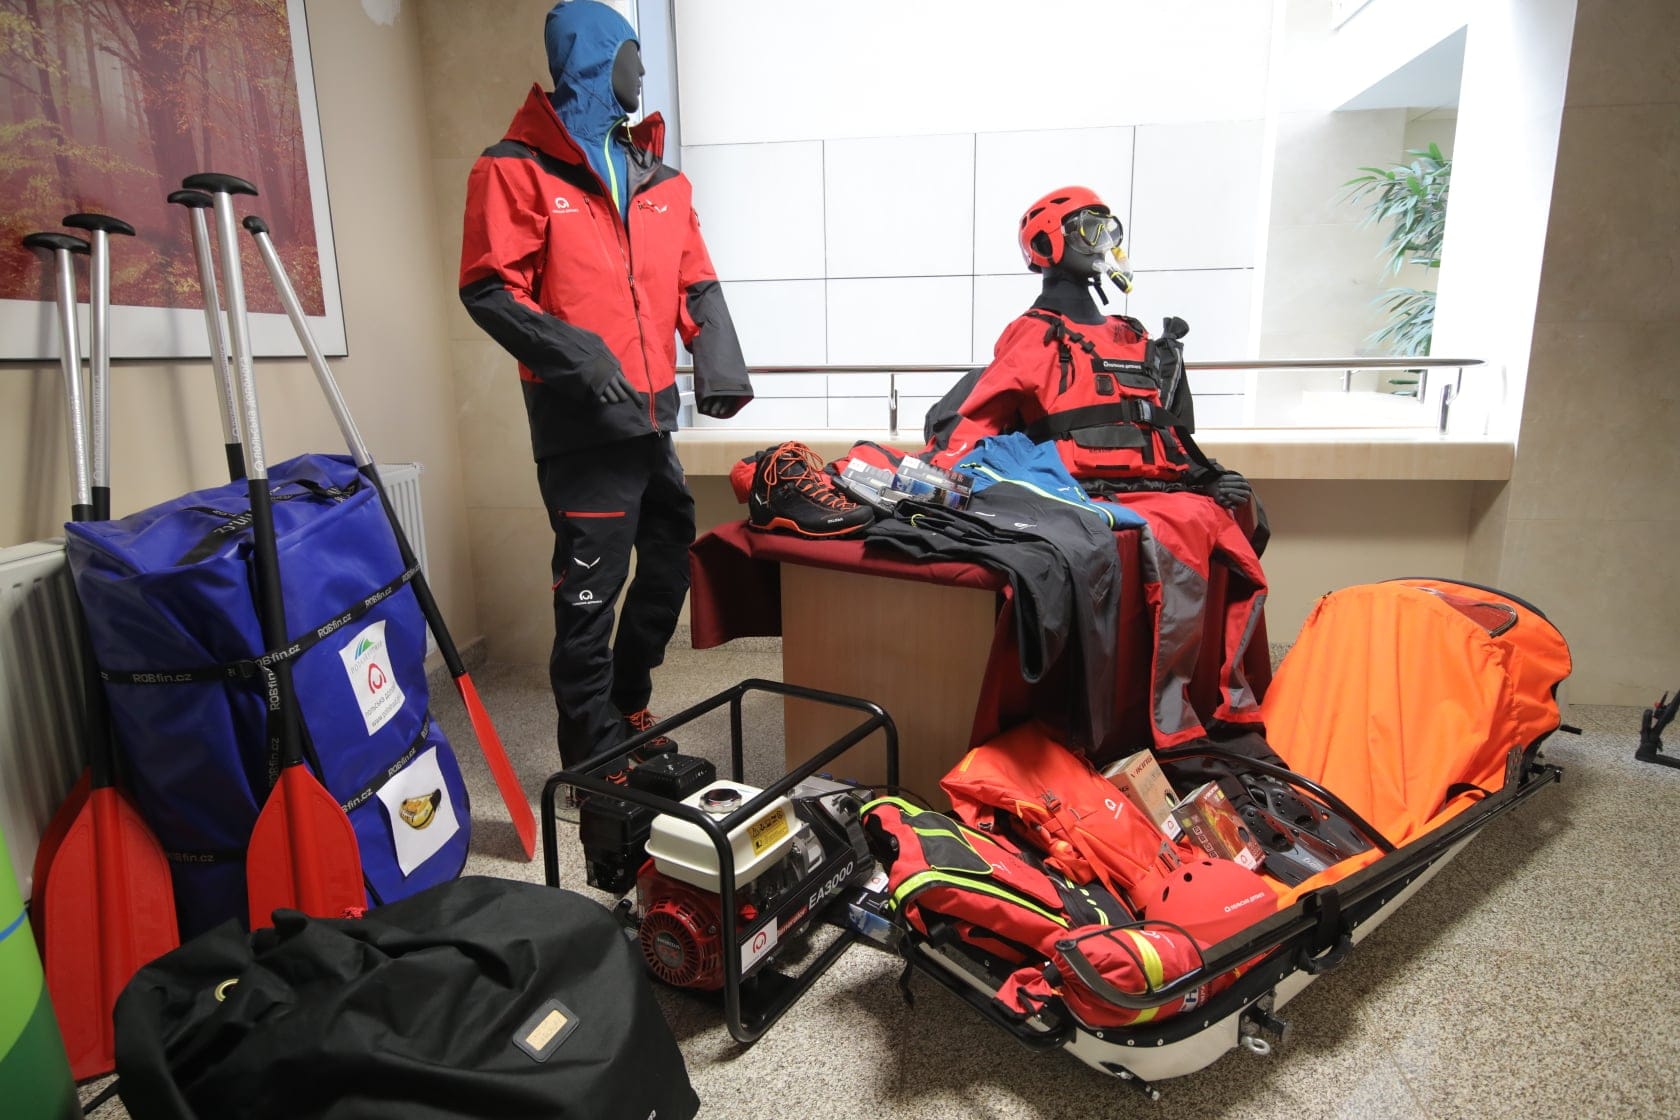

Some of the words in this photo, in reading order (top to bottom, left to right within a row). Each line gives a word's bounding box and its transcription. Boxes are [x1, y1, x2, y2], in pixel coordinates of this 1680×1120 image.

[317, 613, 352, 639] ROBfin.cz
[254, 644, 301, 667] OBfin.cz
[132, 673, 192, 683] ROBfin.cz
[341, 788, 373, 813] Bfin.cz
[808, 861, 854, 910] EA3000
